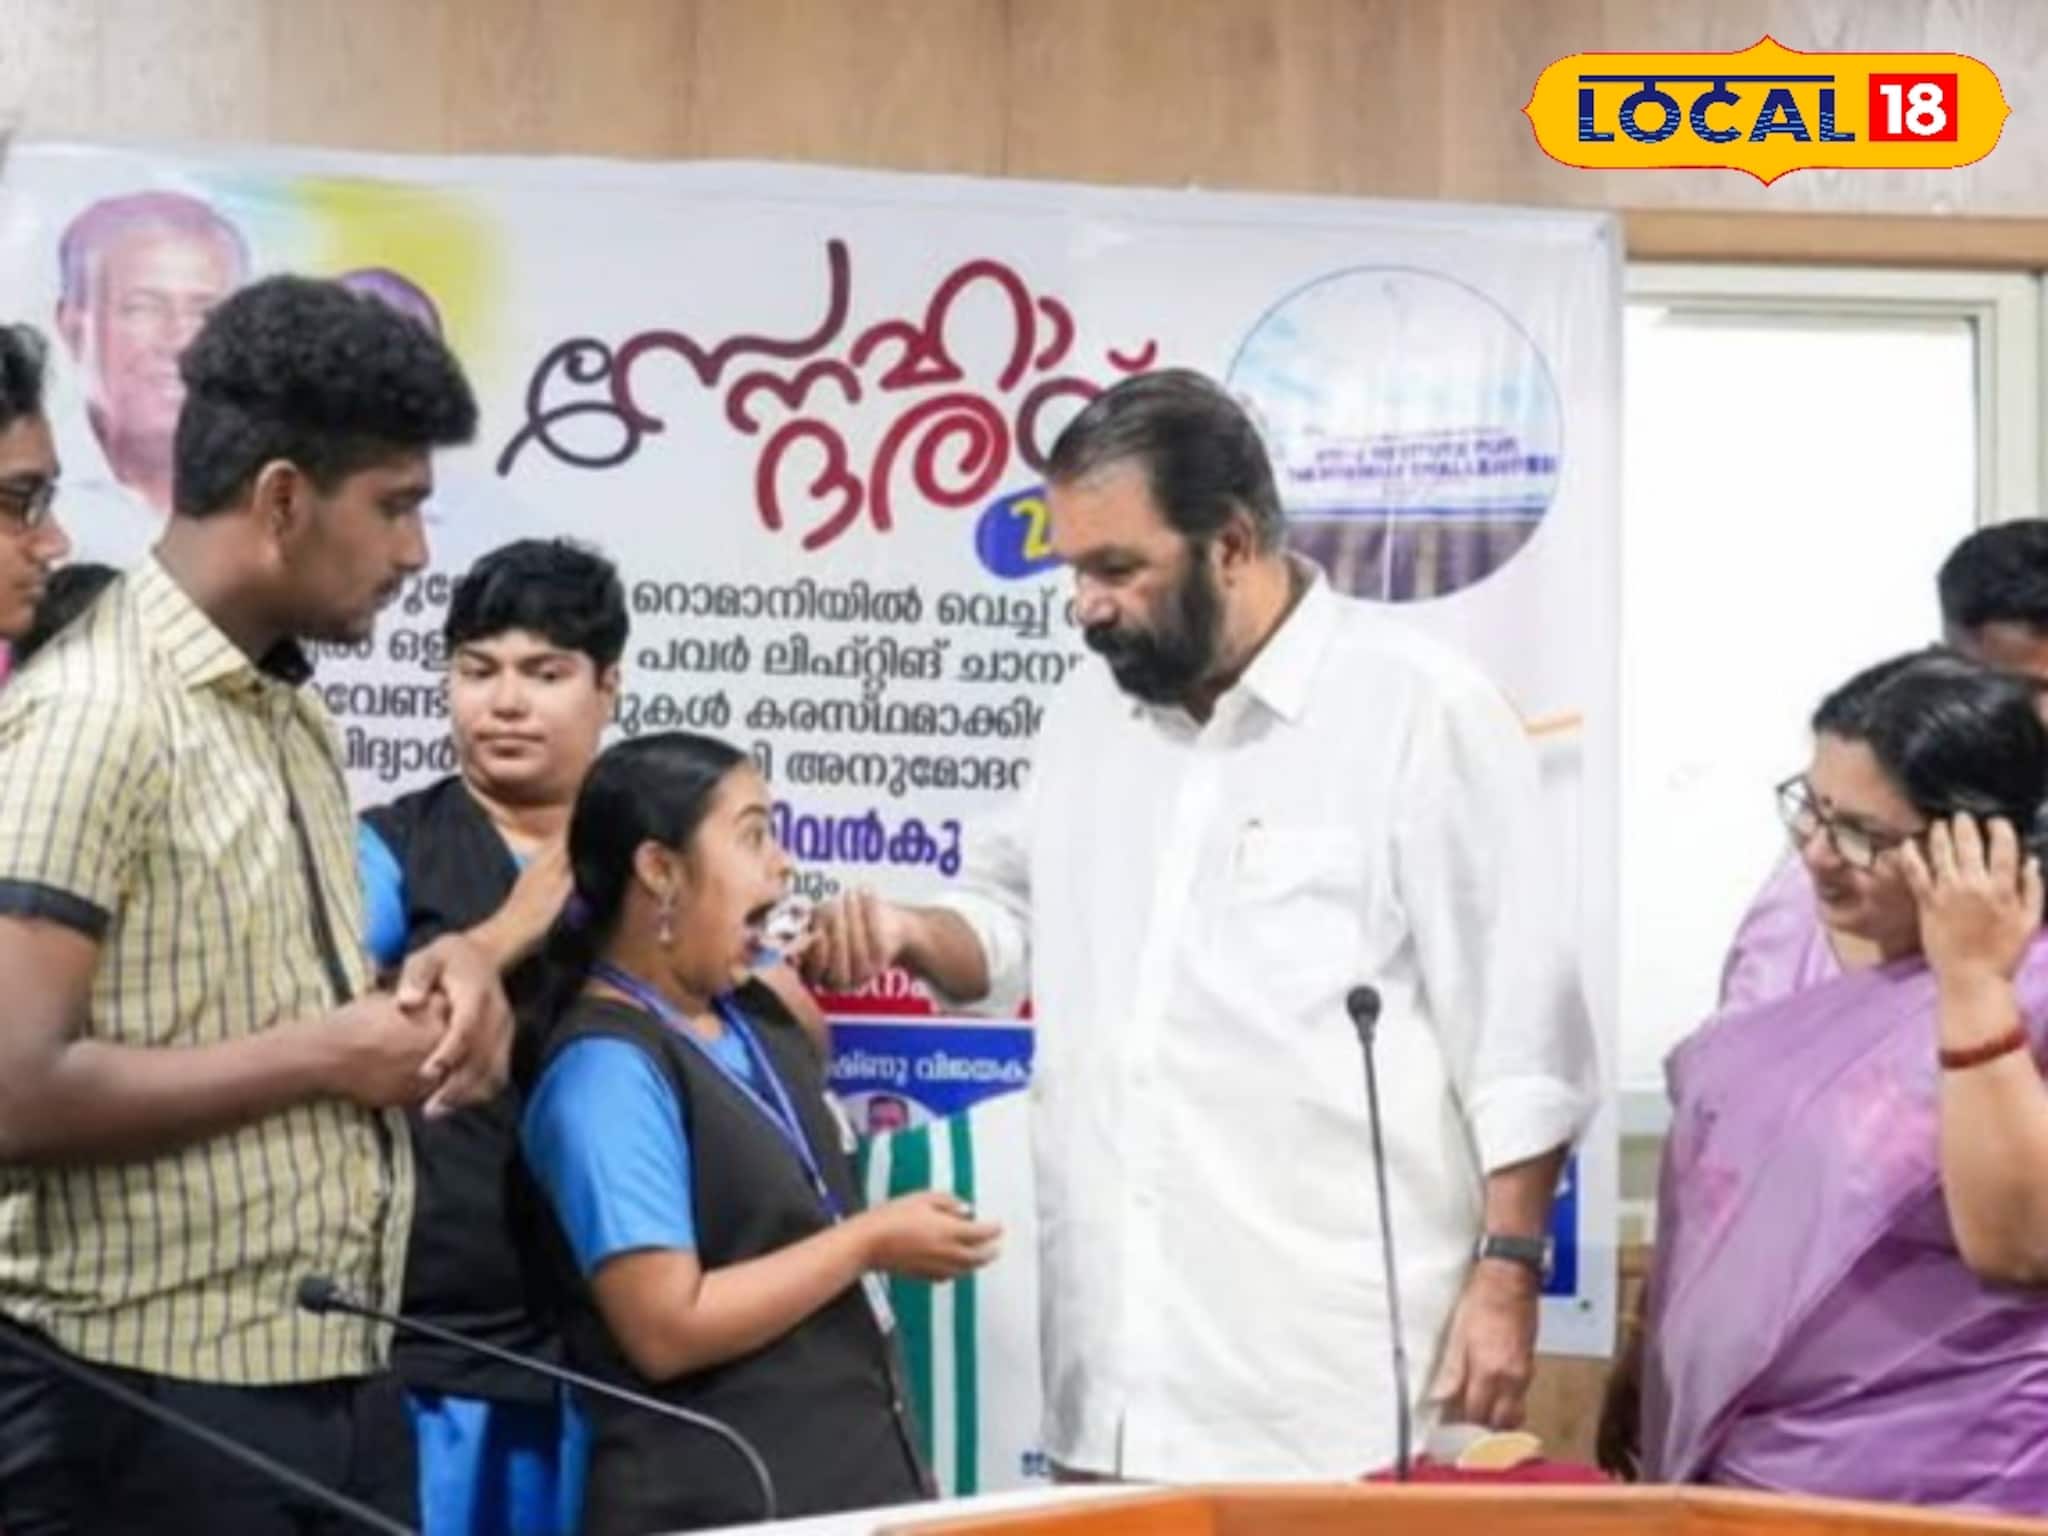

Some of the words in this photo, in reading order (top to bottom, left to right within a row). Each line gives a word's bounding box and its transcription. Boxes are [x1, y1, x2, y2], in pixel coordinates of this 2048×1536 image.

[632, 576, 922, 624] റൊമാനിയിൽ
[937, 585, 1057, 639] വെച്ച്
[636, 633, 751, 674] പവർ
[745, 693, 1044, 738] കരസ്ഥമാക്കി
